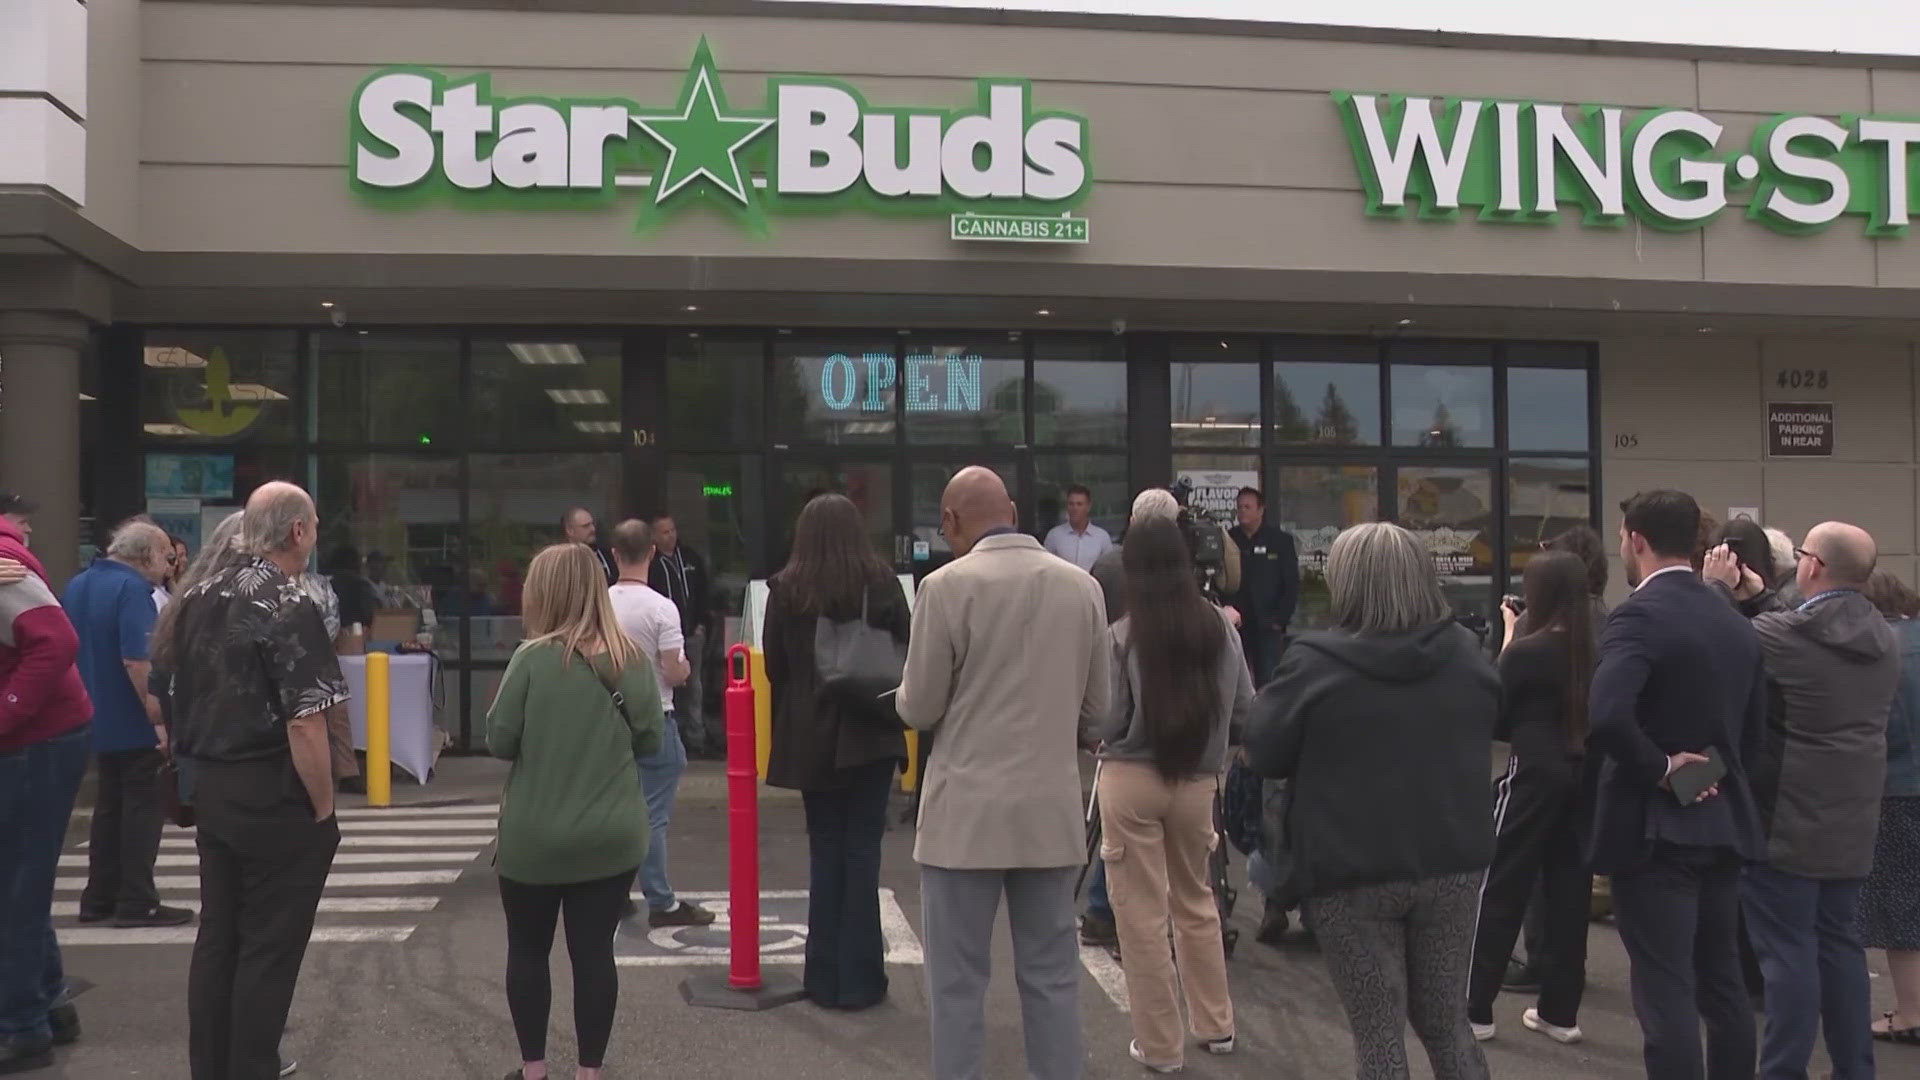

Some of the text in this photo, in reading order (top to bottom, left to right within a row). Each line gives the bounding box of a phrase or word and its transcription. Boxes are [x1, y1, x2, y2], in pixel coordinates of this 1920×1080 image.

[356, 72, 1085, 200] Star Buds
[957, 219, 1084, 238] CANNABIS 21+
[821, 353, 982, 412] OPEN
[1776, 370, 1829, 389] 4028
[1770, 412, 1831, 423] ADDITIONAL
[1778, 424, 1824, 435] PARKING
[1615, 434, 1639, 449] 105
[1781, 437, 1821, 446] IN REAR
